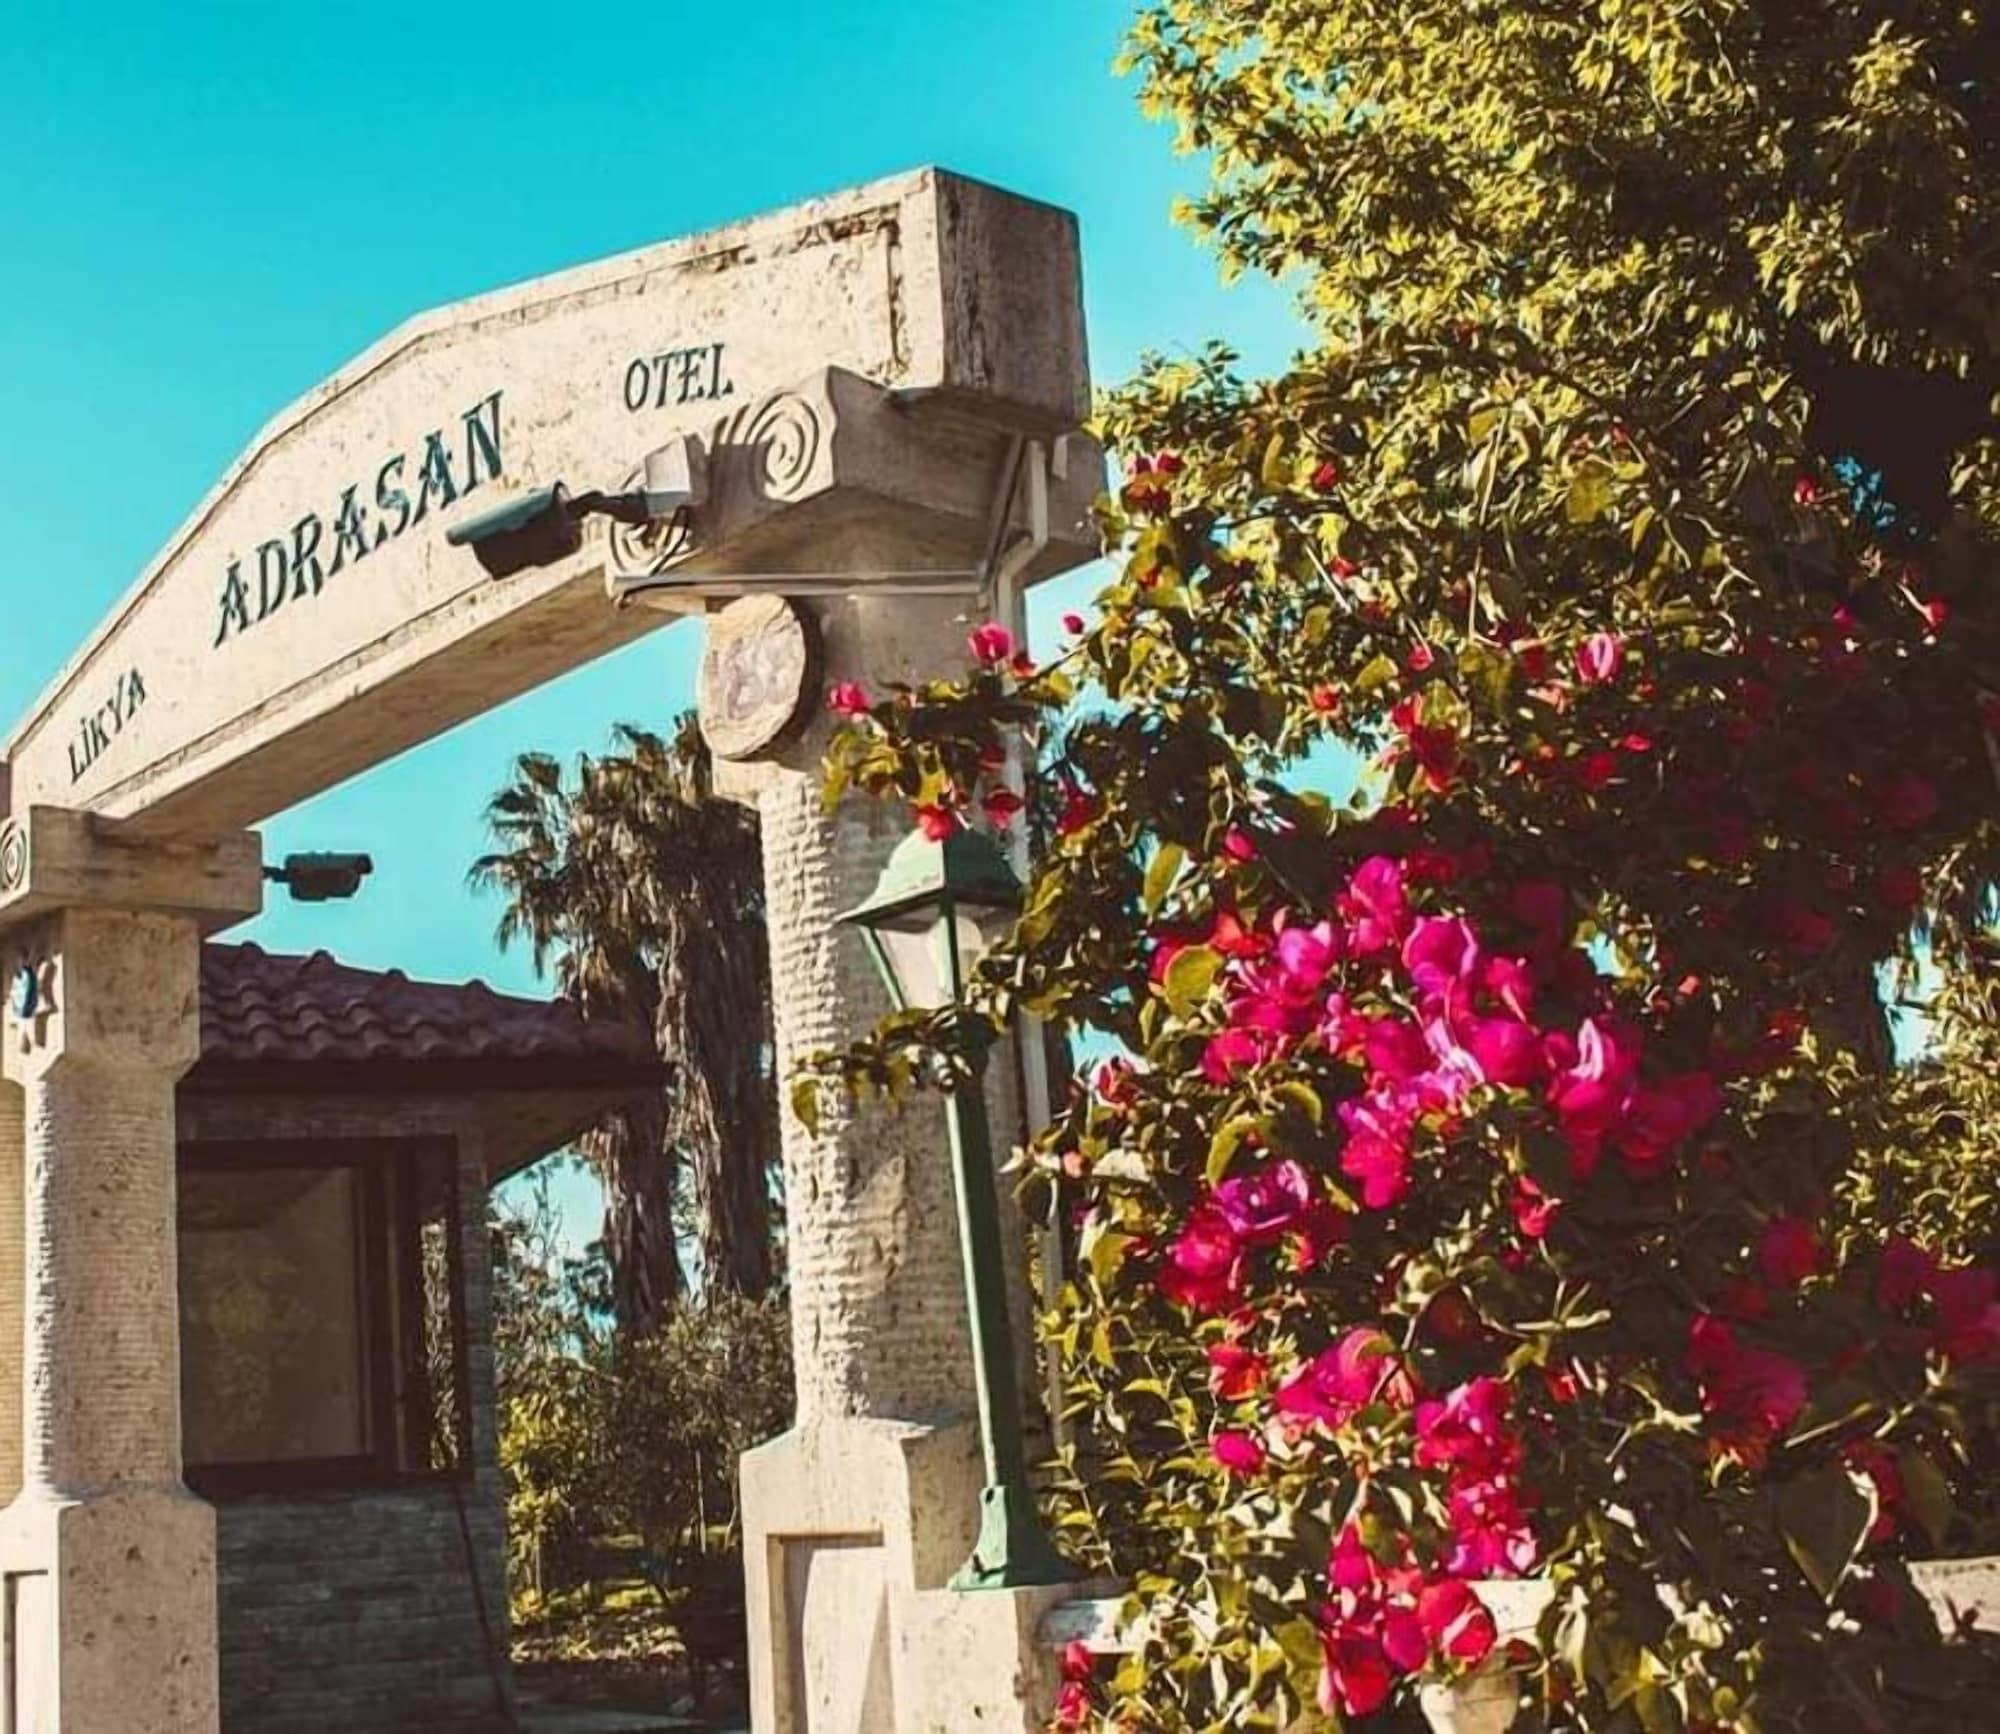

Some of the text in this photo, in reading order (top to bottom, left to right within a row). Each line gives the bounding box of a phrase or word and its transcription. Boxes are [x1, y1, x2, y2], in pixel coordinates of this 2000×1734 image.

[67, 342, 734, 785] LİKYA ADRASAN OTEL
